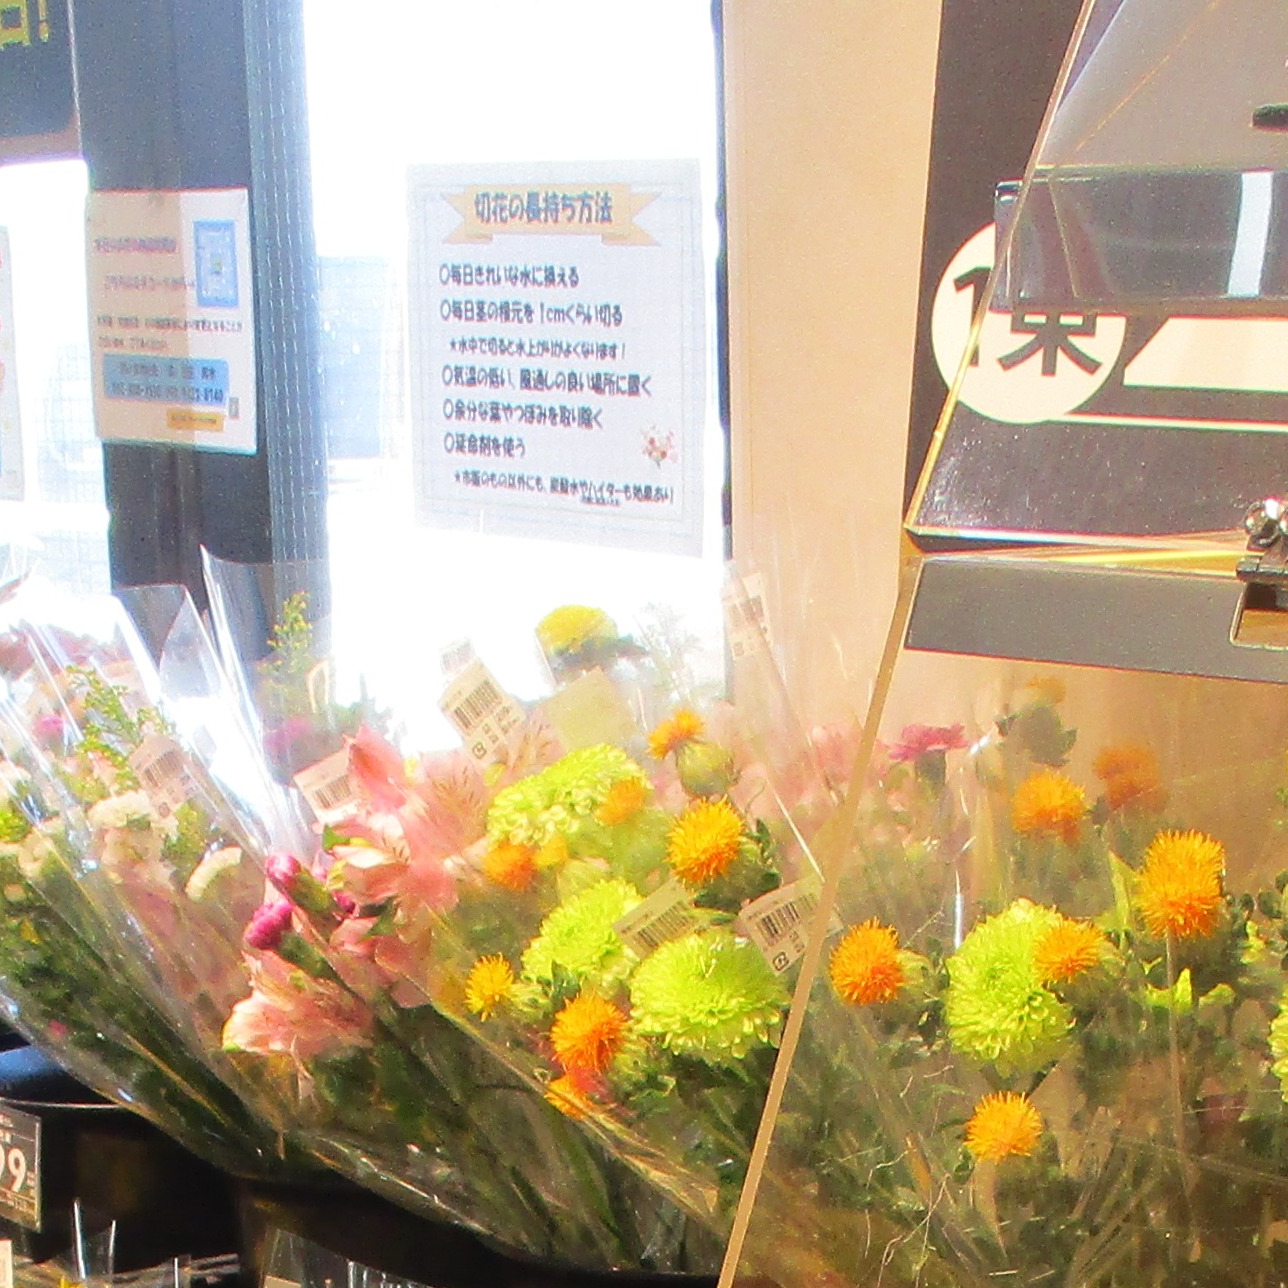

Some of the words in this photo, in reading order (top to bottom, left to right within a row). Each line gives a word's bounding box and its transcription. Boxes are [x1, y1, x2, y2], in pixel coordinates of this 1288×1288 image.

[474, 190, 613, 224] 切花の長持ち方法
